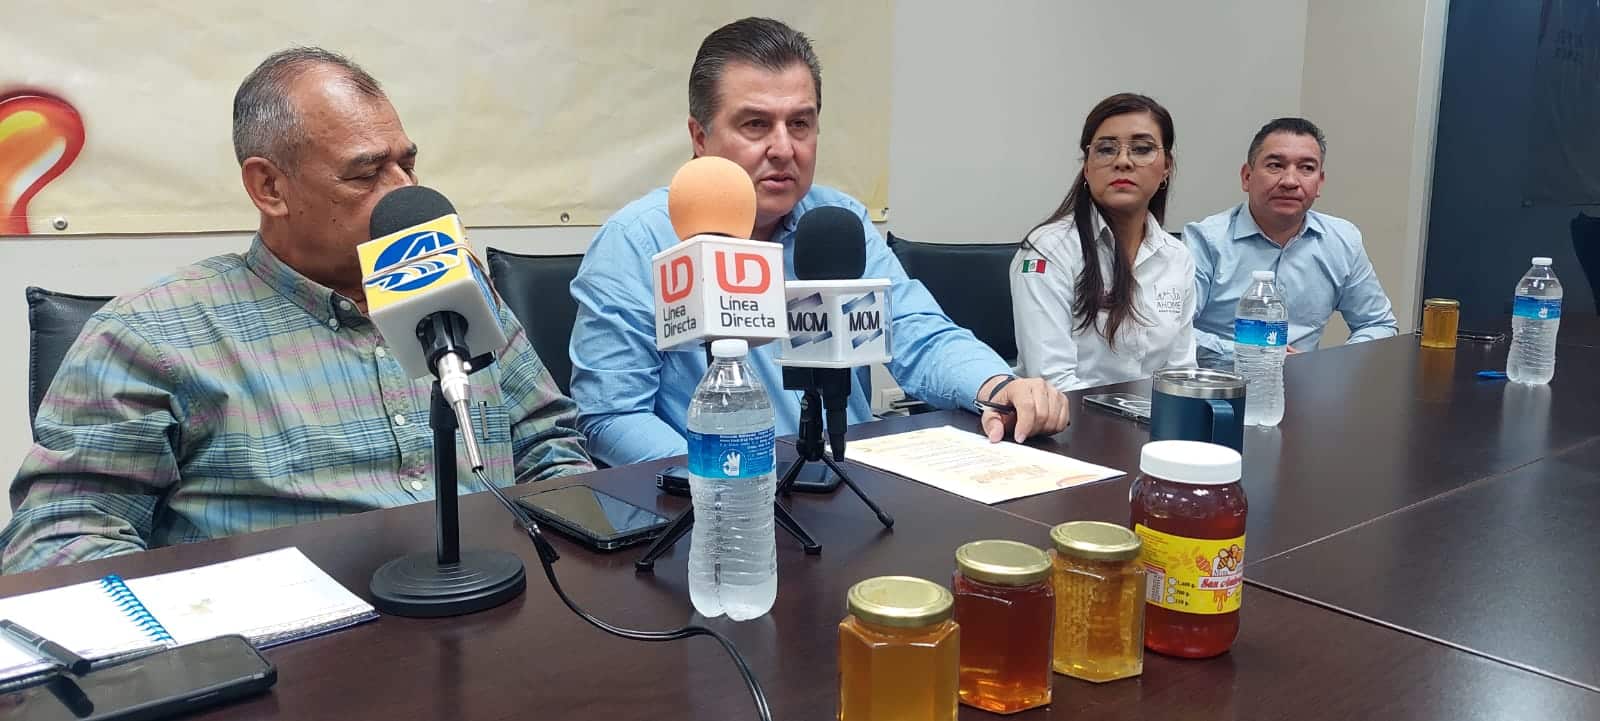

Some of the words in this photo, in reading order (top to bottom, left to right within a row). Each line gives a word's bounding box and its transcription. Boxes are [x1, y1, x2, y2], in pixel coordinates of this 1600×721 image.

[663, 316, 697, 338] Directa
[720, 312, 776, 328] Directa
[788, 312, 828, 332] MCM
[848, 310, 881, 331] MCM
